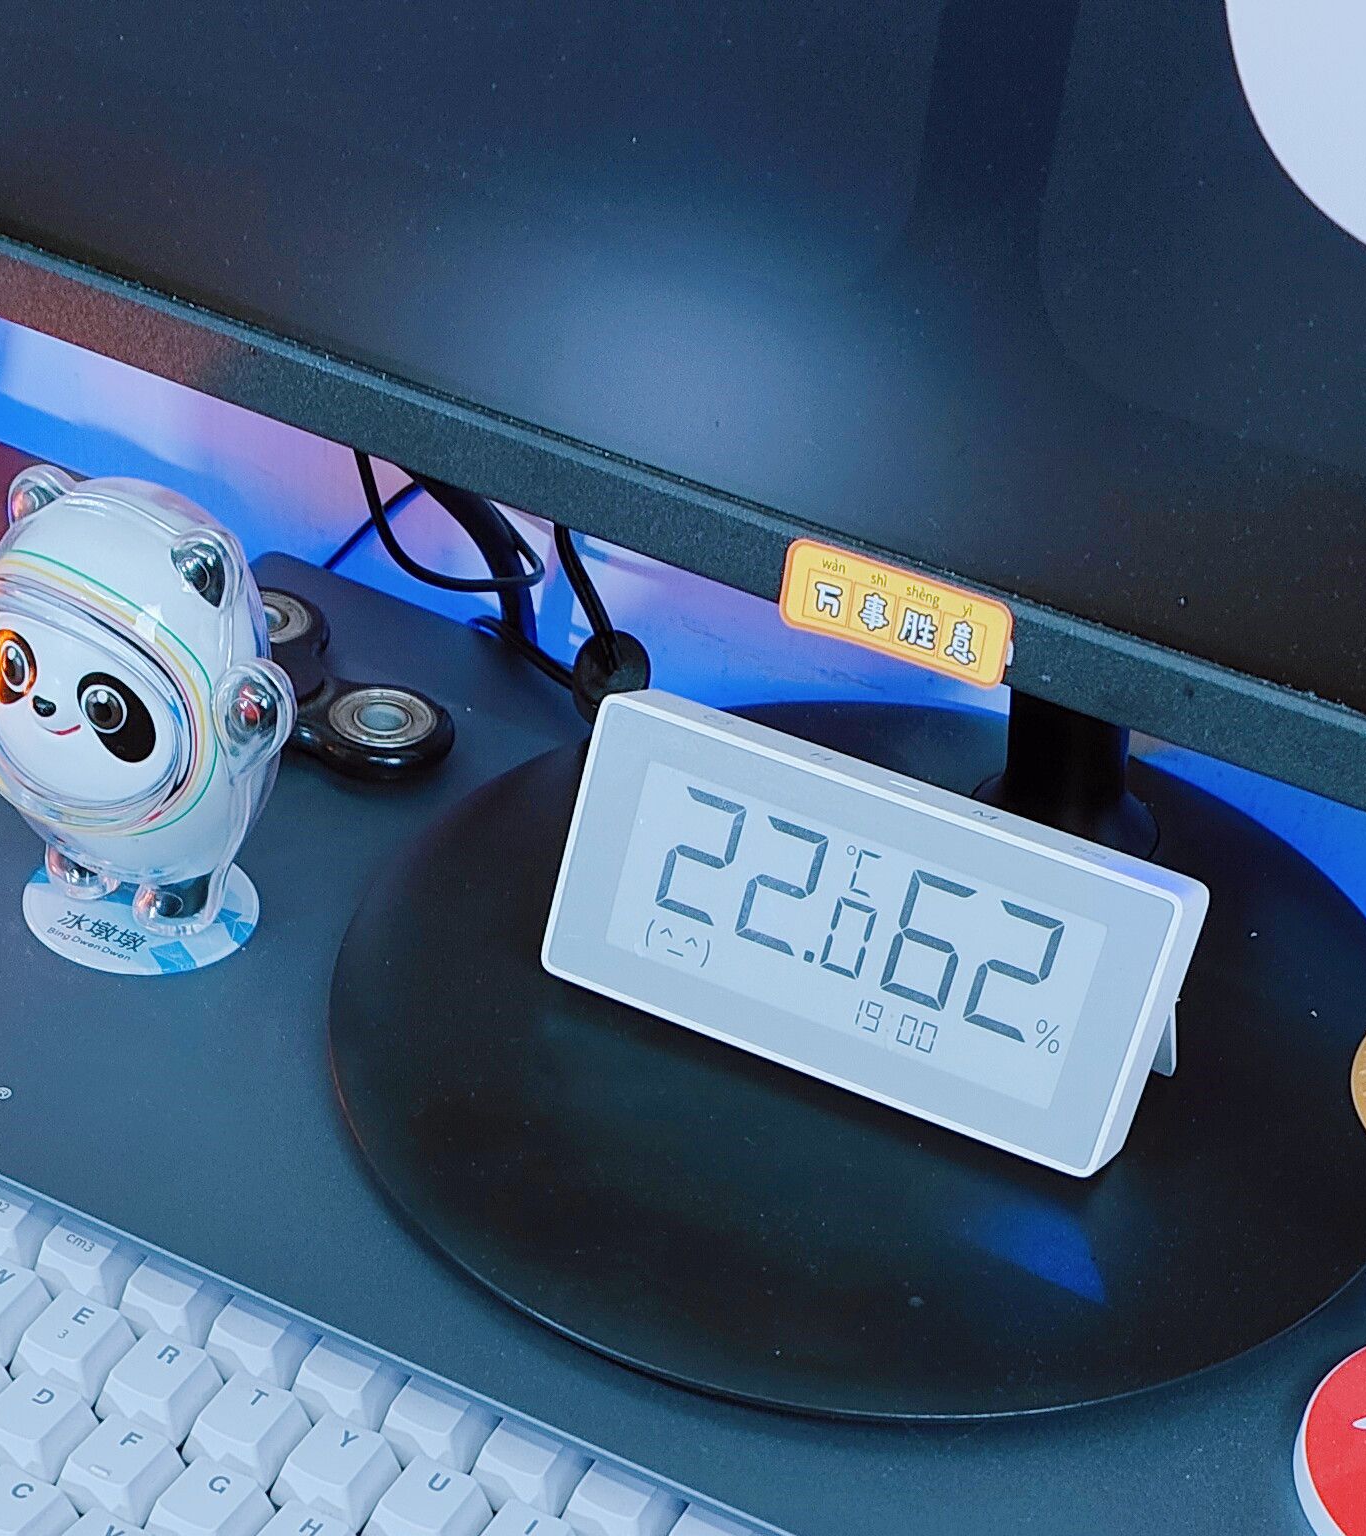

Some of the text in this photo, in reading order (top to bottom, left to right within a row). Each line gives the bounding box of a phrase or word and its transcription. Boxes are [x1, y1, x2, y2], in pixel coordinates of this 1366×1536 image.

[814, 581, 976, 666] 万事胜意
[57, 911, 148, 953] 冰墩墩
[65, 1232, 96, 1253] cm3
[72, 1306, 95, 1325] E
[156, 1345, 181, 1365] R
[32, 1388, 55, 1405] D
[250, 1388, 270, 1406] T
[120, 1431, 144, 1447] F
[340, 1430, 360, 1448] Y
[11, 1483, 35, 1498] C
[208, 1475, 231, 1494] G
[428, 1472, 452, 1491] U
[299, 1518, 324, 1536] H
